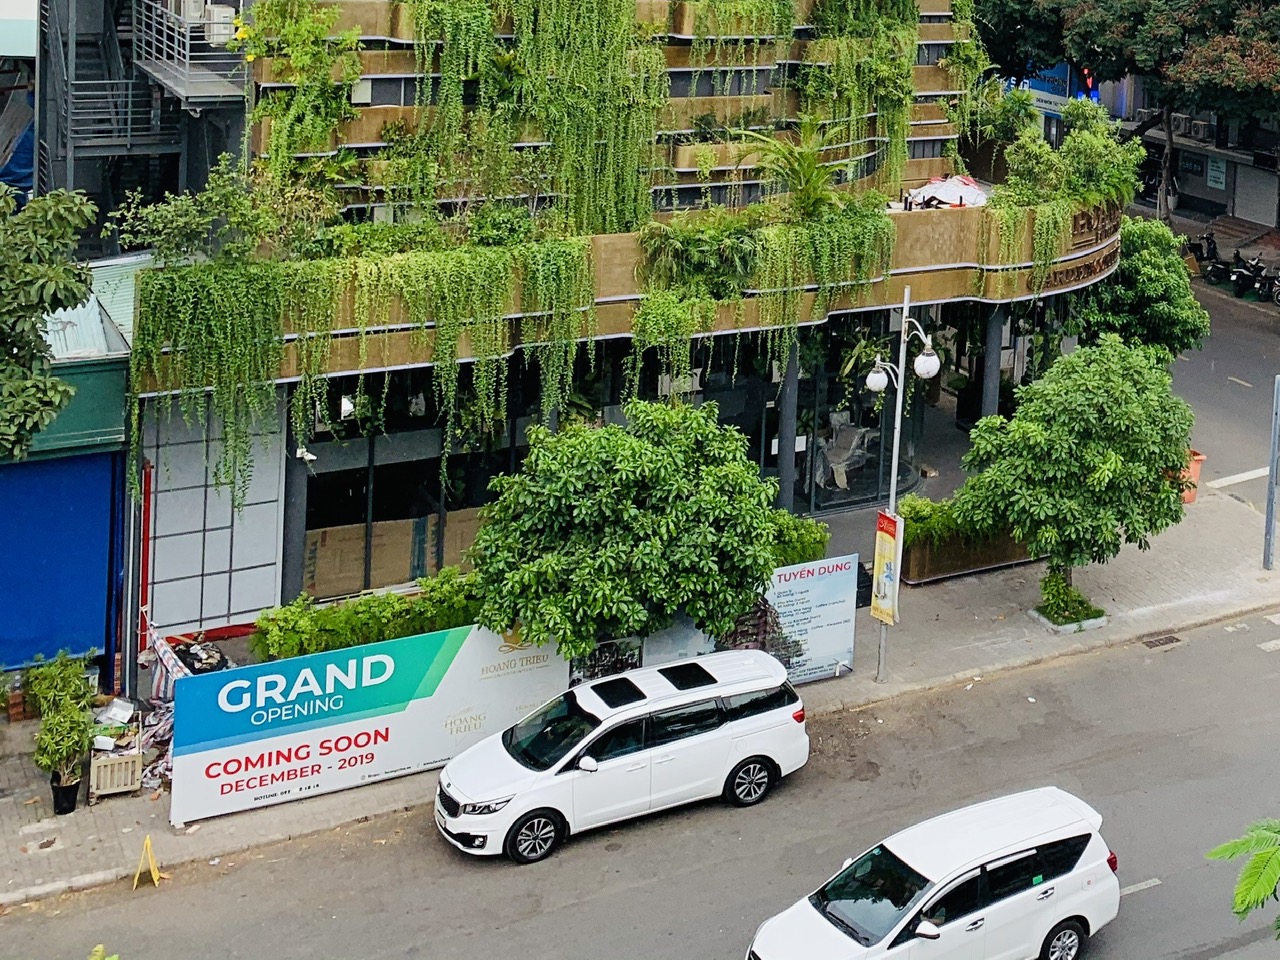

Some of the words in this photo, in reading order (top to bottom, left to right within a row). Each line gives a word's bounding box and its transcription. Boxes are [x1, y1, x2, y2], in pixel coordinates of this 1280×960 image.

[818, 561, 852, 576] DỤNG
[217, 653, 396, 713] GRAND
[250, 694, 344, 726] OPENING
[204, 744, 311, 780] COMING
[318, 727, 390, 758] SOON
[219, 763, 322, 796] DECEMBER
[337, 752, 375, 772] 2019
